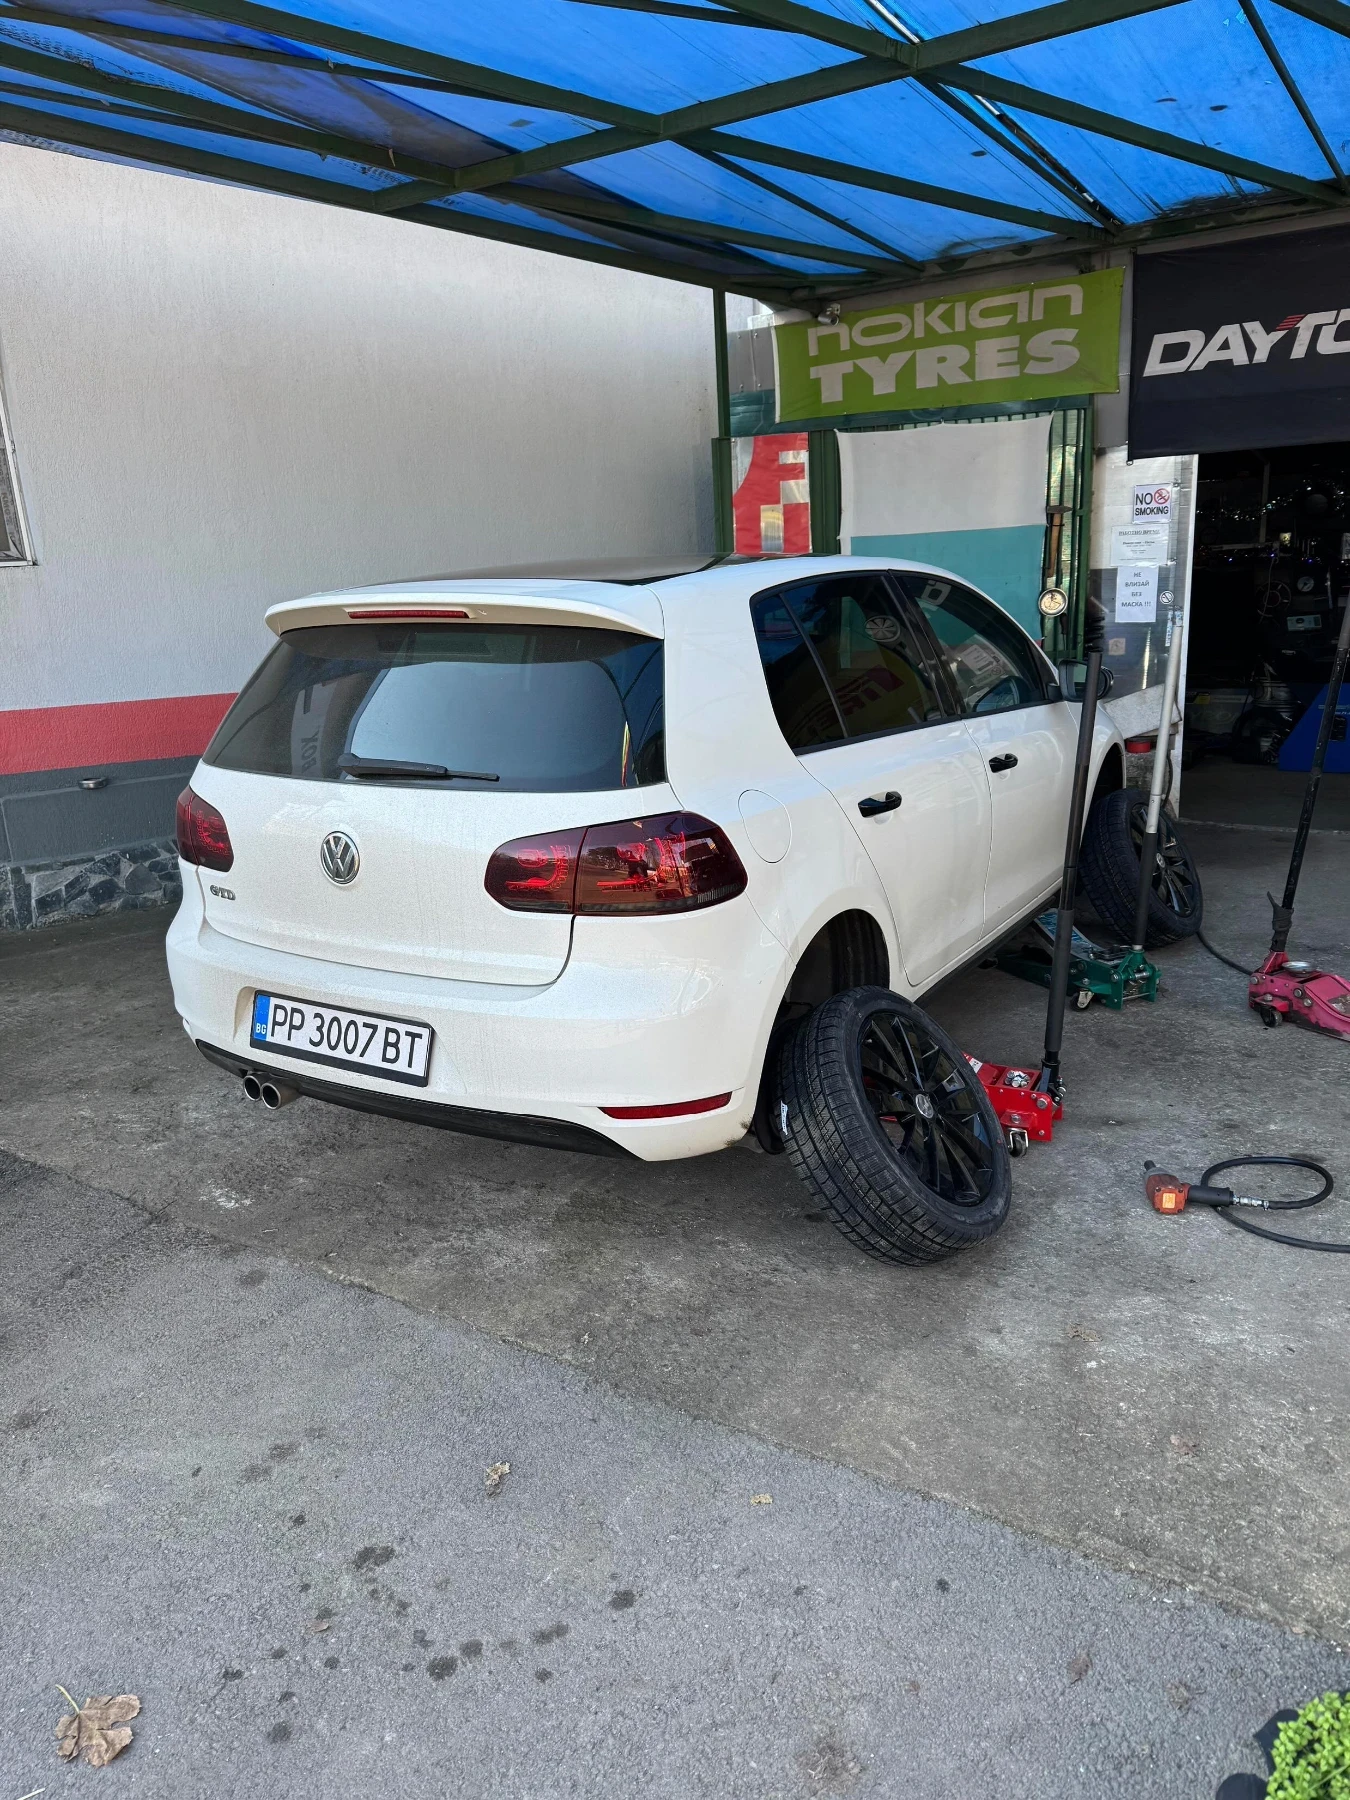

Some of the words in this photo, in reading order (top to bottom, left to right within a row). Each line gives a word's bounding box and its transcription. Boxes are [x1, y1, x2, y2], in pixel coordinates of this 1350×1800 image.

[810, 328, 1081, 404] TYRES
[1135, 493, 1153, 505] NO
[1135, 506, 1169, 516] SMOKING
[209, 884, 236, 901] GTD
[255, 1022, 267, 1034] BG
[270, 1003, 305, 1041] PP
[308, 1012, 379, 1058] 3007
[381, 1026, 423, 1069] BT
